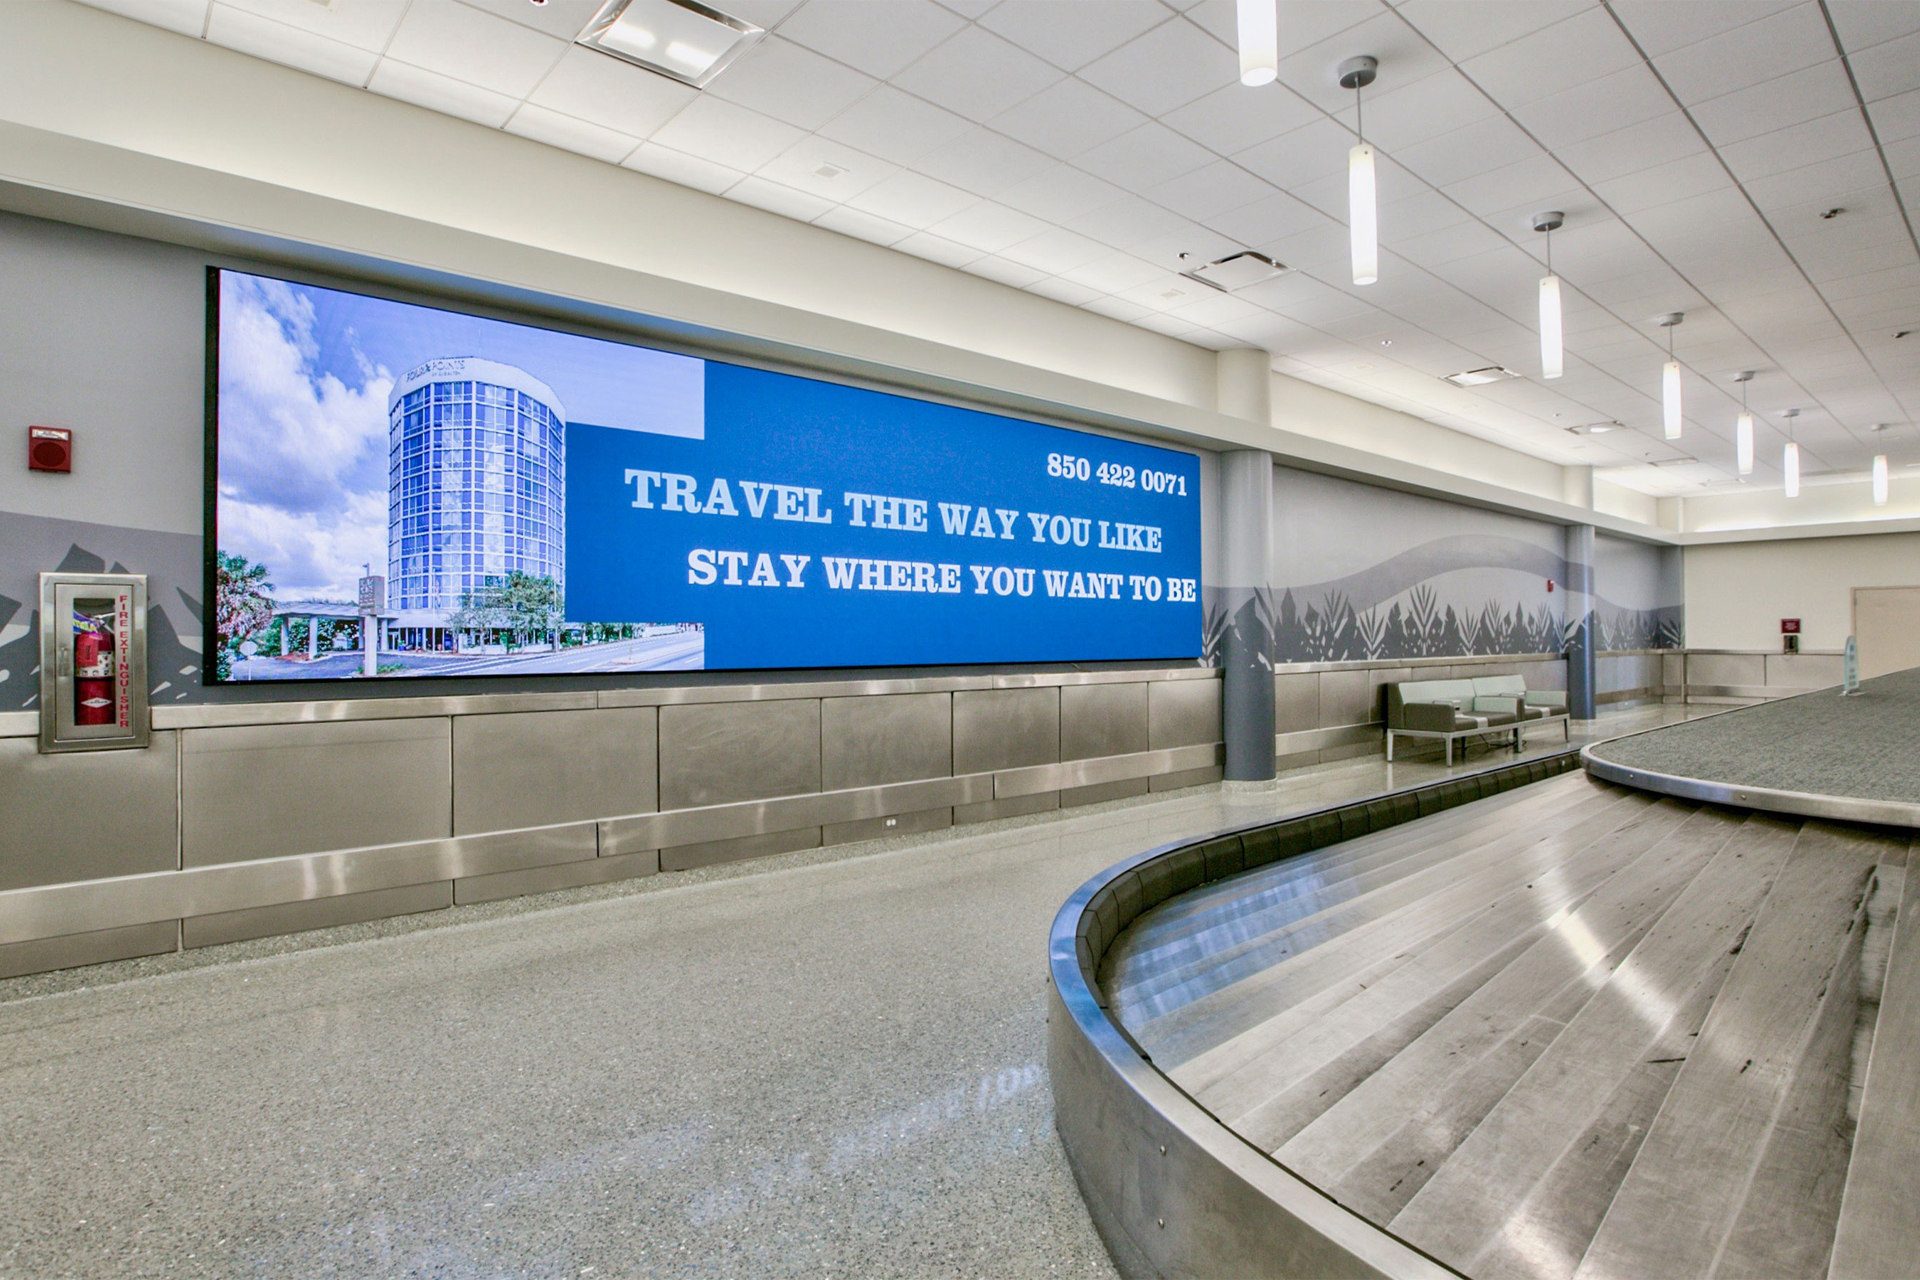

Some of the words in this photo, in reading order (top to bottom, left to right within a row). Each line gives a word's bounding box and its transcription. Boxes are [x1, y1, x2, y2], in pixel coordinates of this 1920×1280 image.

[1047, 453, 1091, 482] 850
[1095, 462, 1136, 489] 422
[1140, 469, 1188, 498] 0071
[624, 468, 832, 524] TRAVEL
[843, 491, 928, 533] THE
[937, 502, 1020, 540] WAY
[1027, 512, 1092, 547] YOU
[1098, 520, 1162, 553] LIKE
[688, 548, 811, 587] STAY
[821, 556, 962, 595] WHERE
[969, 565, 1036, 597] YOU
[1042, 569, 1124, 601] WANT
[1129, 575, 1162, 602] TO
[1166, 577, 1197, 603] BE
[119, 595, 129, 627] FIRE
[119, 631, 130, 728] EXTINGUISHER
